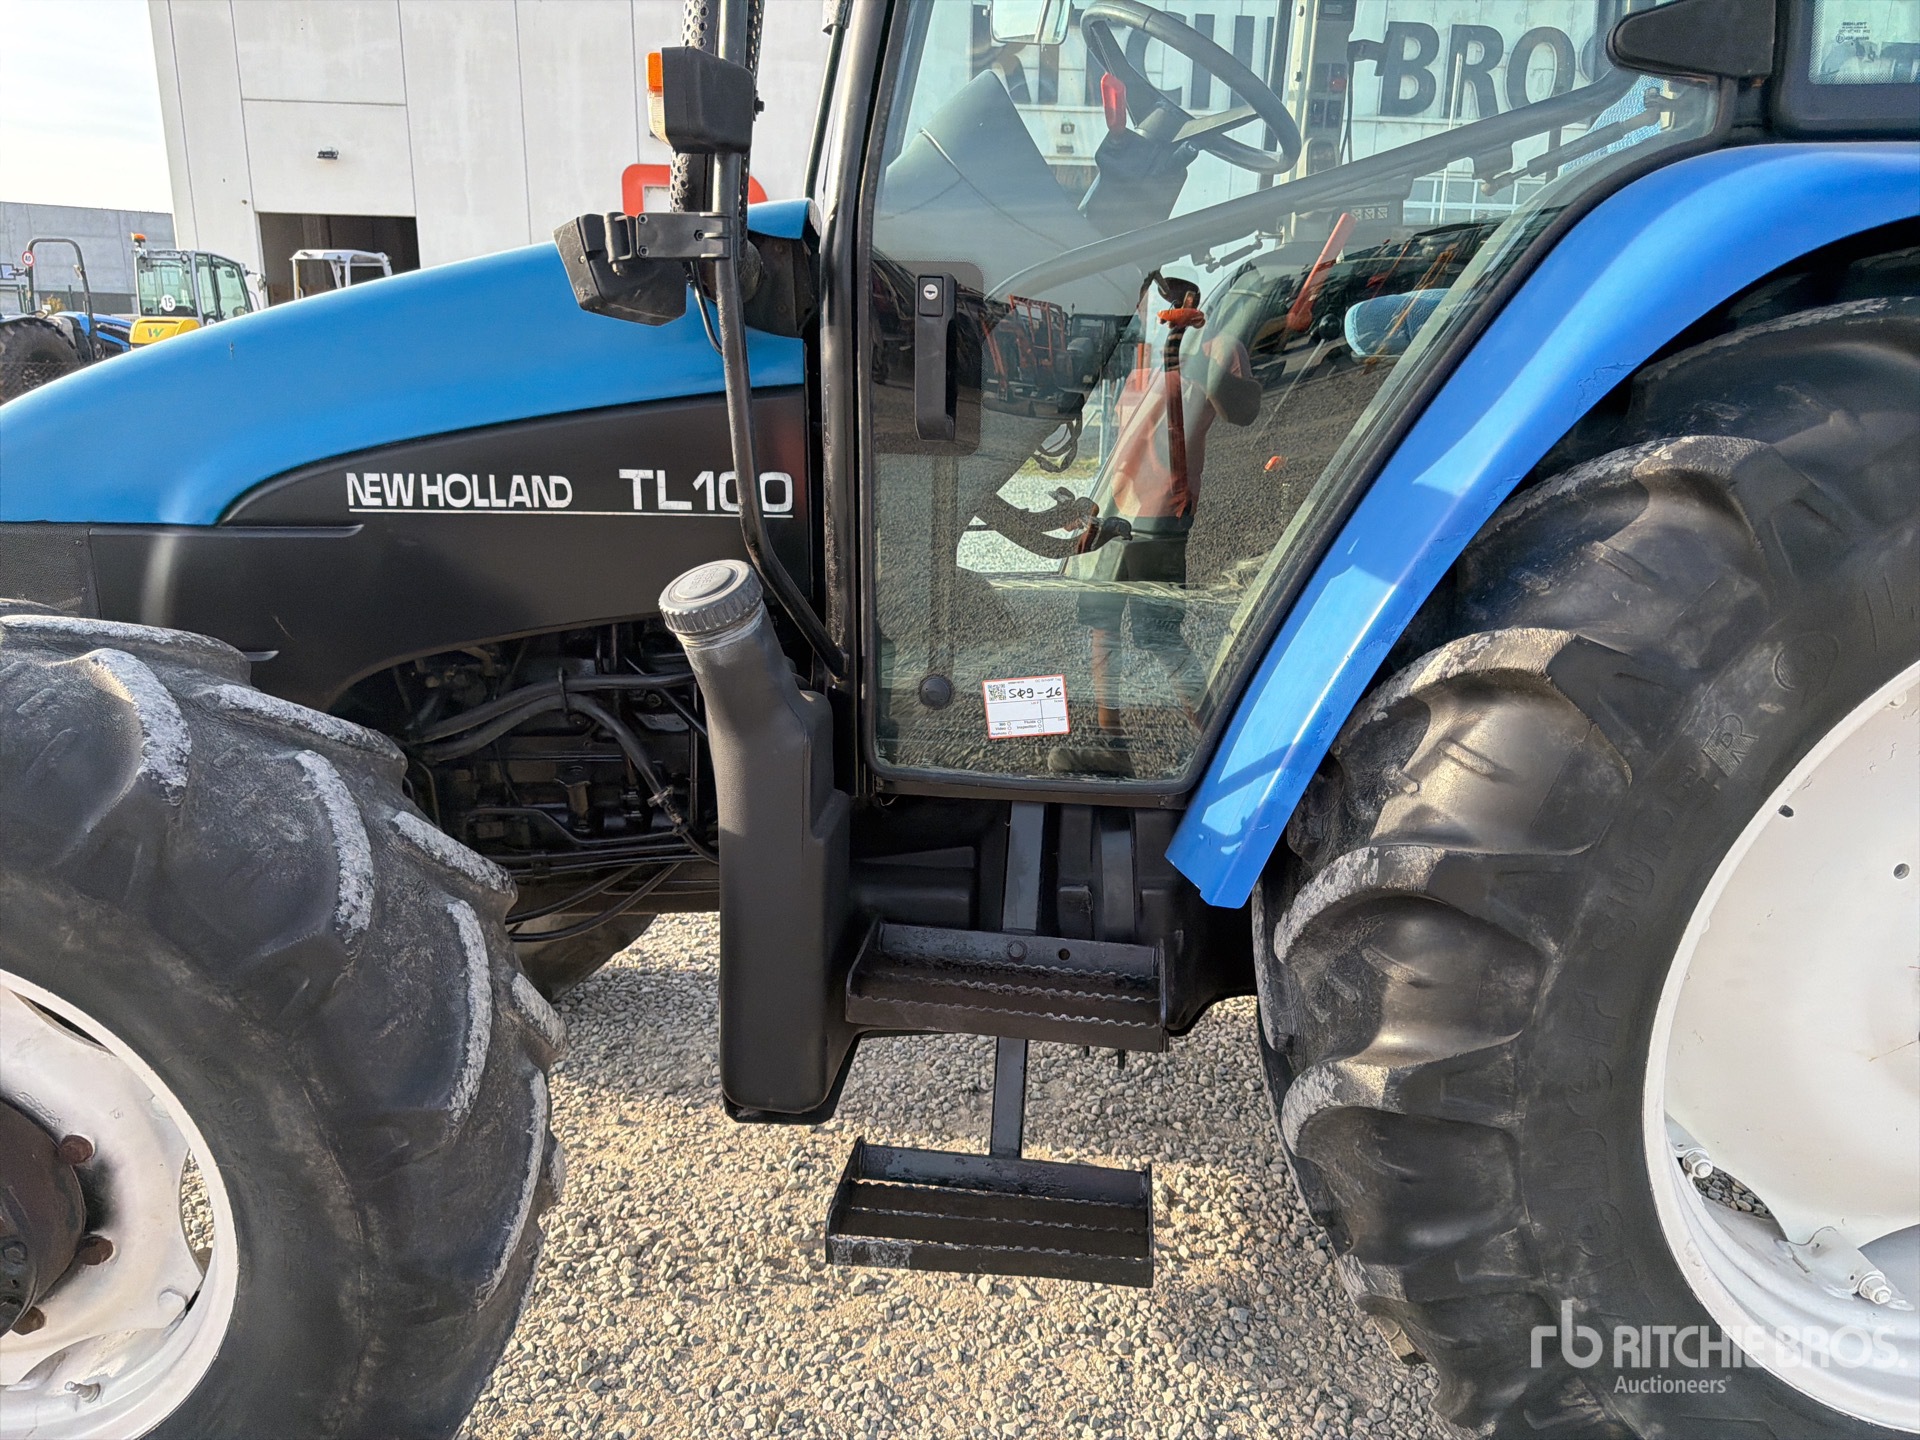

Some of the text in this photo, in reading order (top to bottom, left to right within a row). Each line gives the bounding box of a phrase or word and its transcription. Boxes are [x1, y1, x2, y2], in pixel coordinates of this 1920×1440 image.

[164, 297, 173, 306] 15
[346, 472, 415, 507] NEW
[421, 473, 573, 508] HOLLAND
